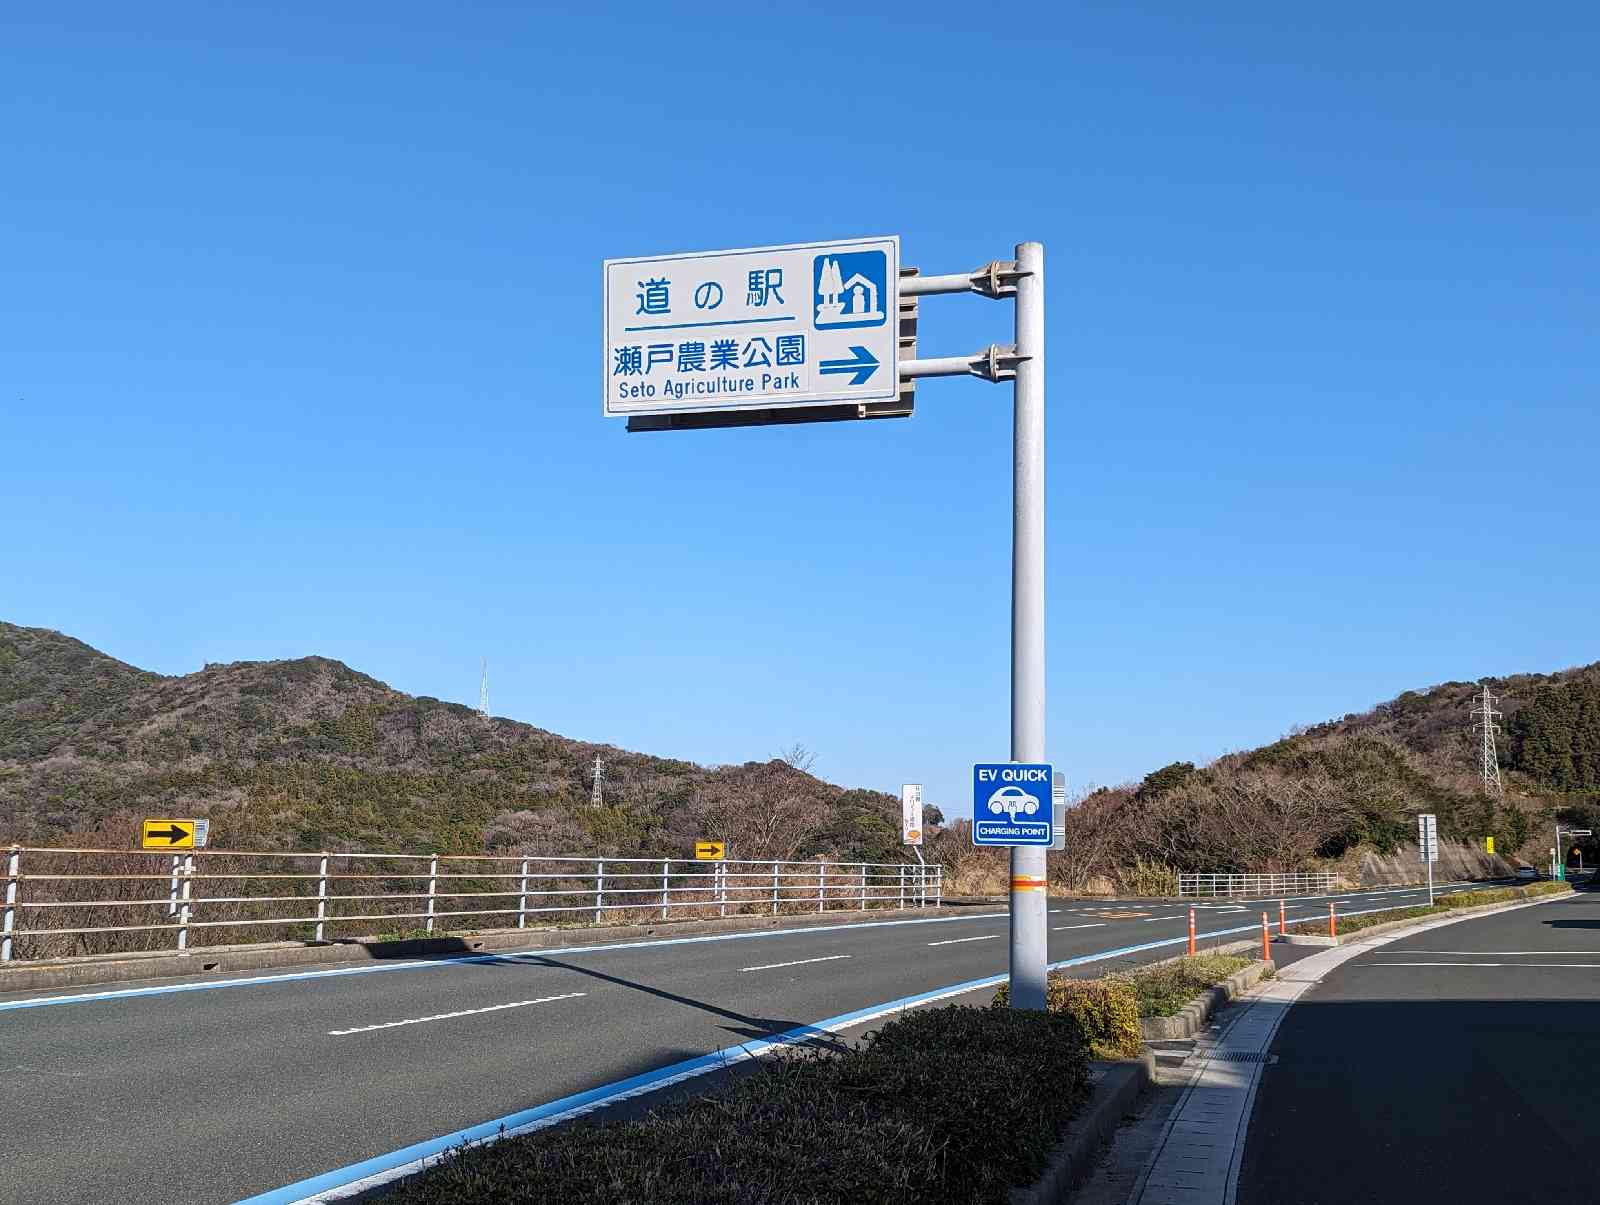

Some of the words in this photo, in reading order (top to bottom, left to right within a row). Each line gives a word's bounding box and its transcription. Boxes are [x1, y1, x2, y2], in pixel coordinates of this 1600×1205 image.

[635, 268, 785, 316] 道の駅
[612, 334, 806, 377] 瀬戸農業公園
[619, 381, 656, 399] Seto
[663, 376, 755, 400] Agriculture
[761, 371, 800, 391] Park
[979, 769, 998, 782] EV
[1001, 769, 1048, 782] QUICK
[979, 827, 1021, 836] CHARGING
[1021, 827, 1046, 836] POINT
